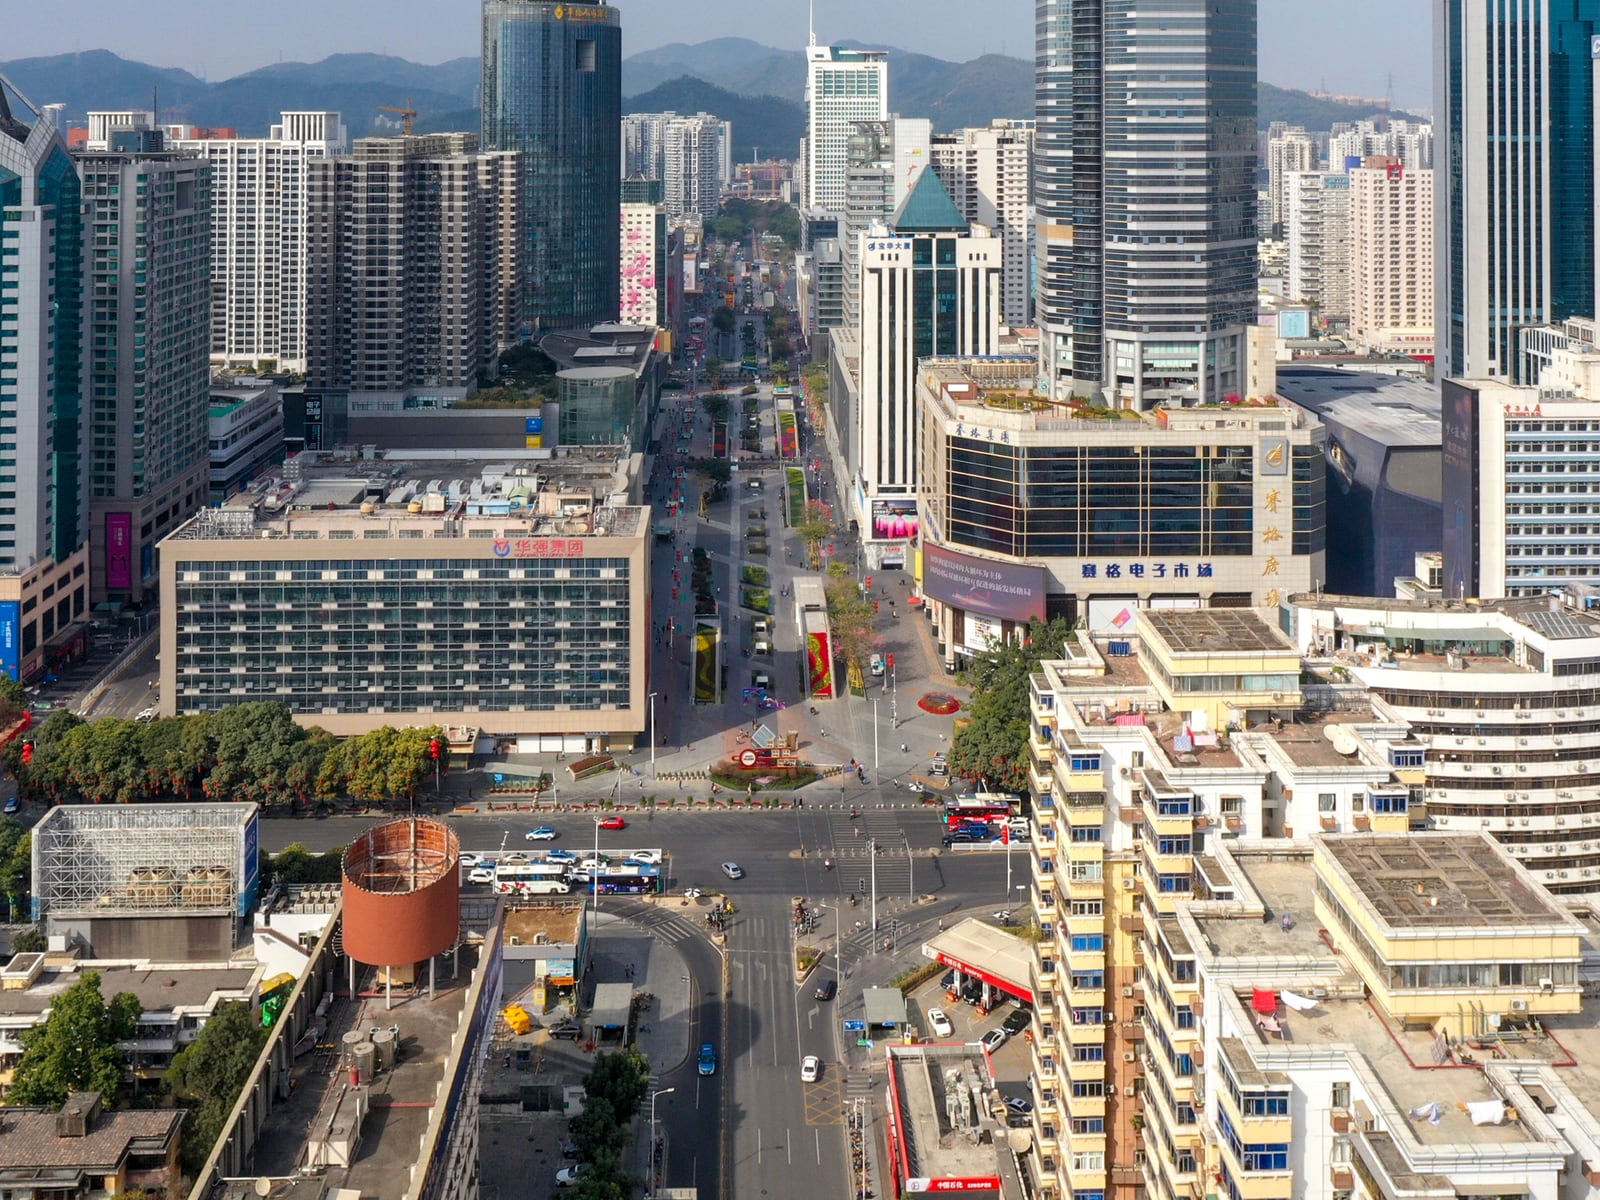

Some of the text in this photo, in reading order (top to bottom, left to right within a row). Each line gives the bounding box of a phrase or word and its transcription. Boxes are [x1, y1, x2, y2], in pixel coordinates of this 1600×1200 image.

[515, 540, 583, 553] 华强集团
[1082, 563, 1213, 578] 赛格电子市场
[937, 1181, 963, 1189] 中国石化
